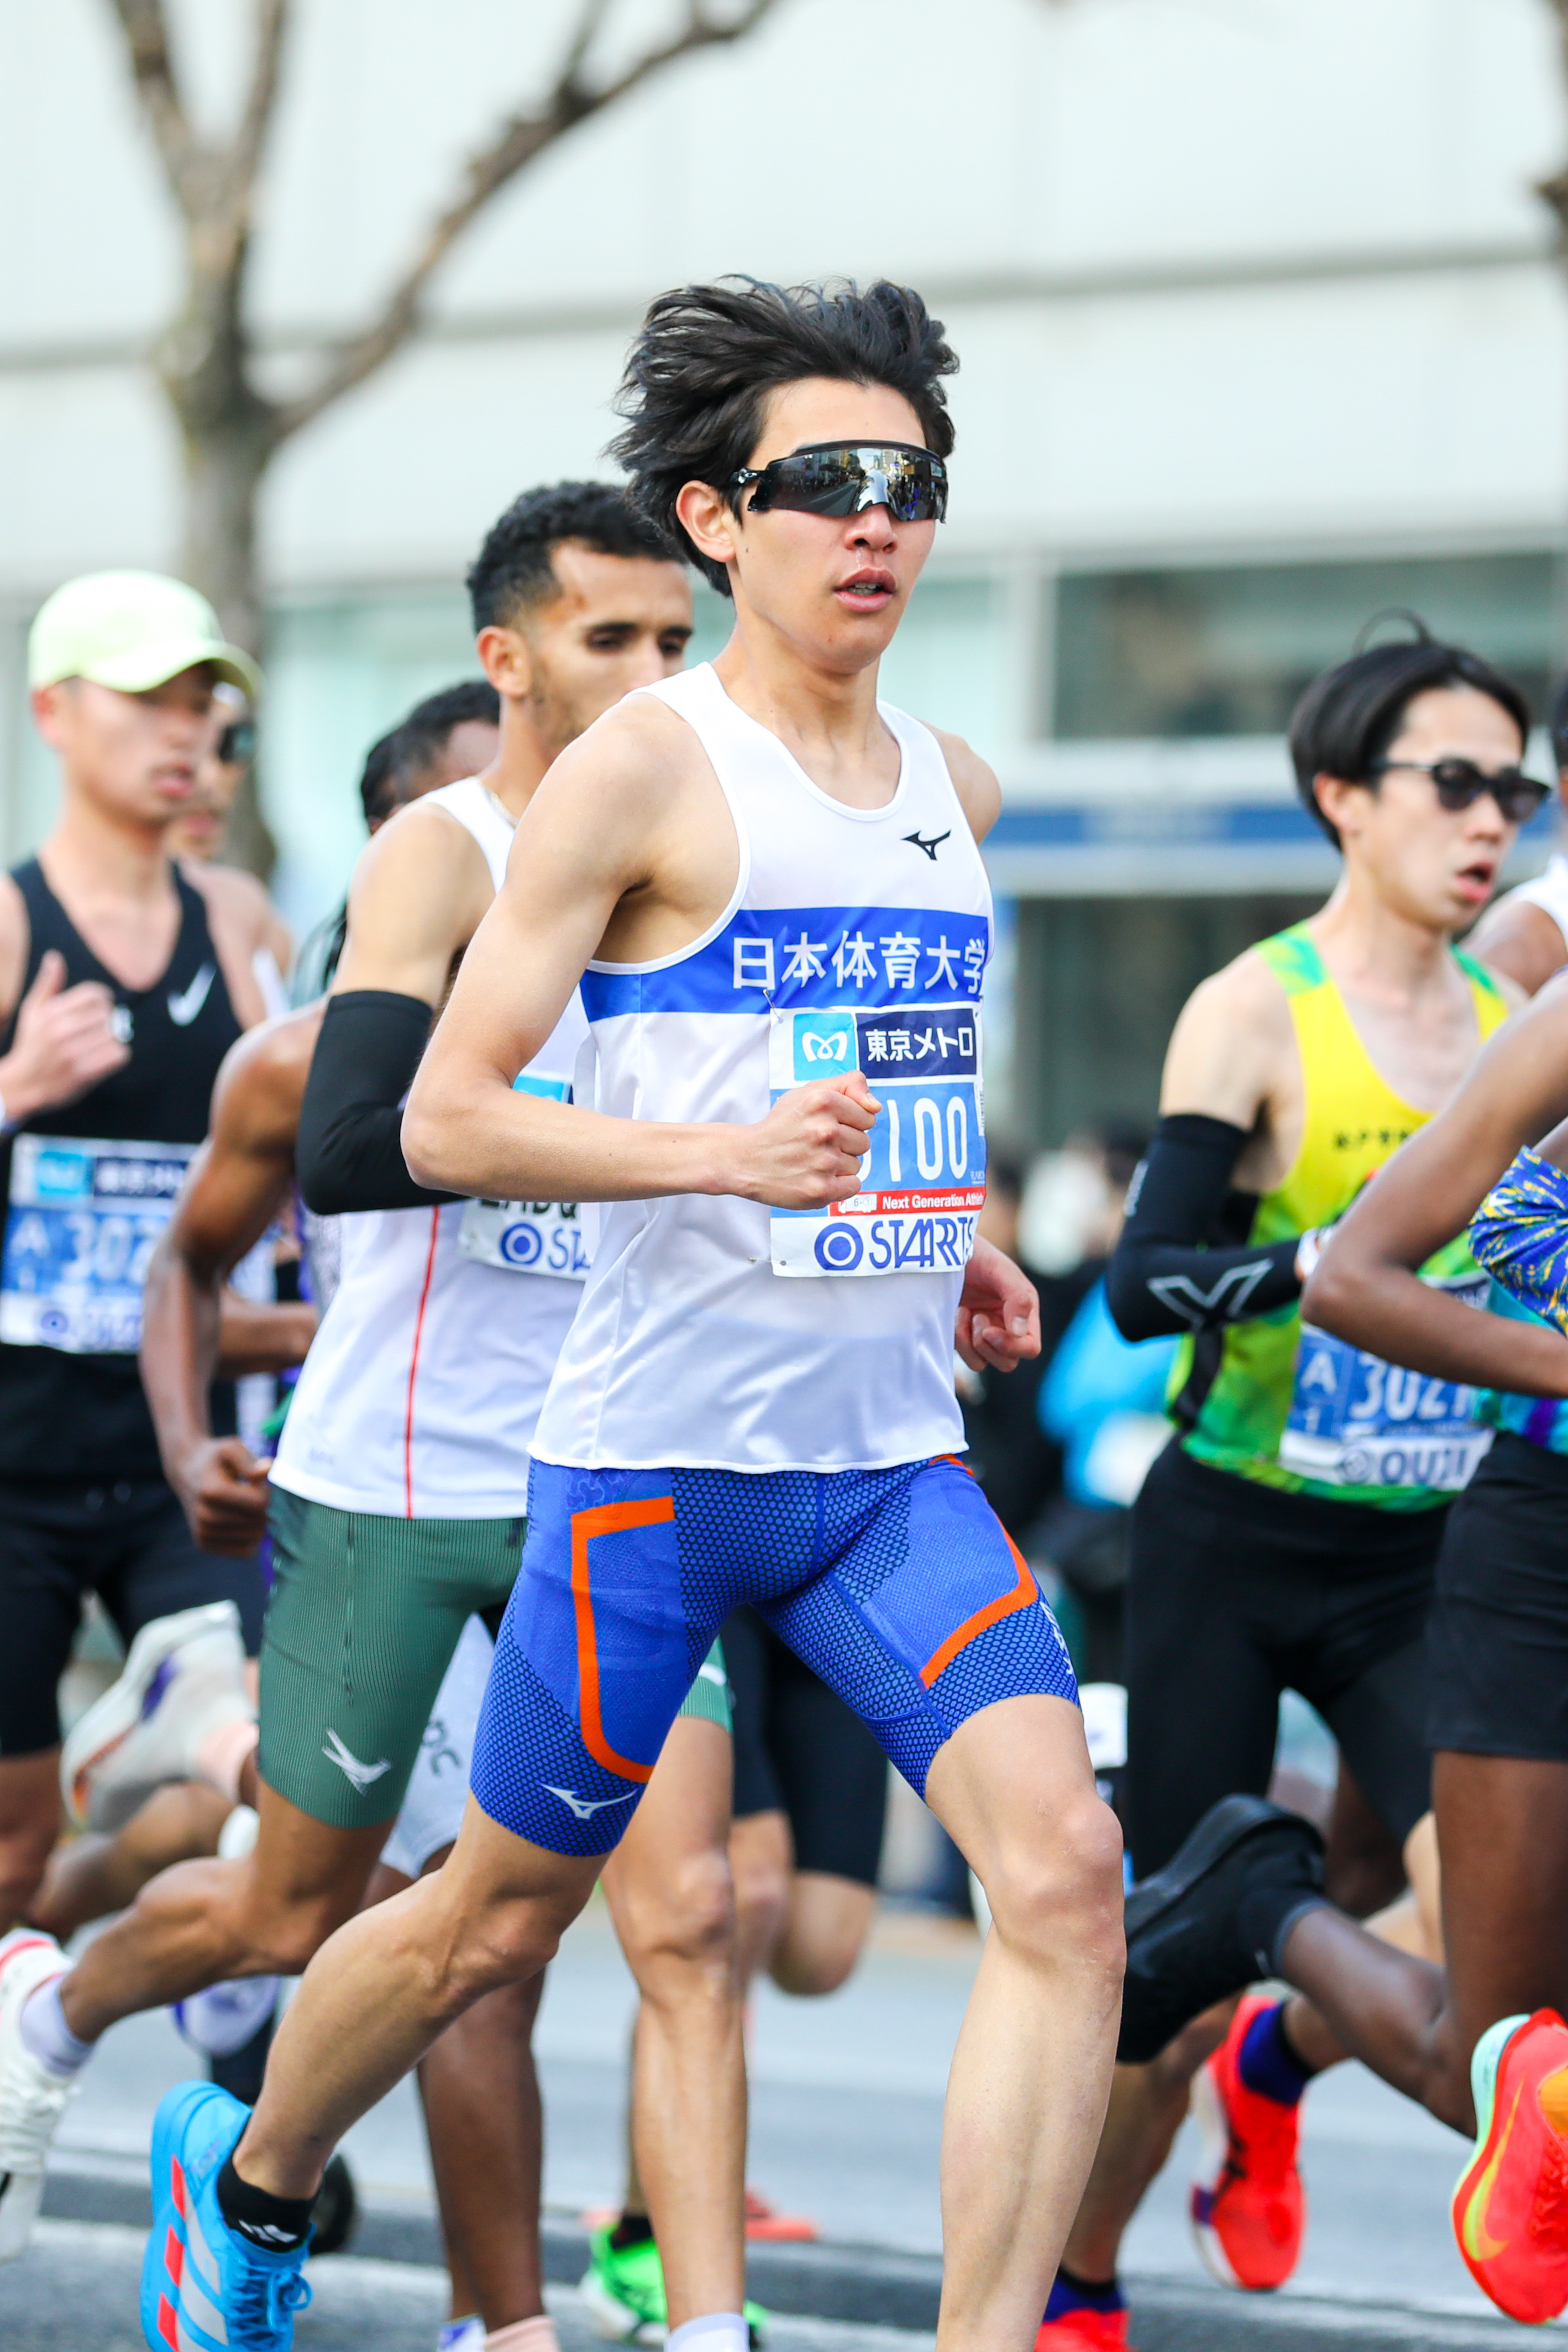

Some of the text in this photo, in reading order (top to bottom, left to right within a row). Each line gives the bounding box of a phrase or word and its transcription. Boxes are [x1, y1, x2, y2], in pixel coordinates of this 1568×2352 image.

[733, 931, 985, 993] 日本体育大学
[866, 1027, 973, 1061] 東京メトロ
[857, 1097, 967, 1182] 100
[883, 1196, 909, 1209] Next
[912, 1193, 964, 1208] Generation
[1300, 1351, 1337, 1394] A
